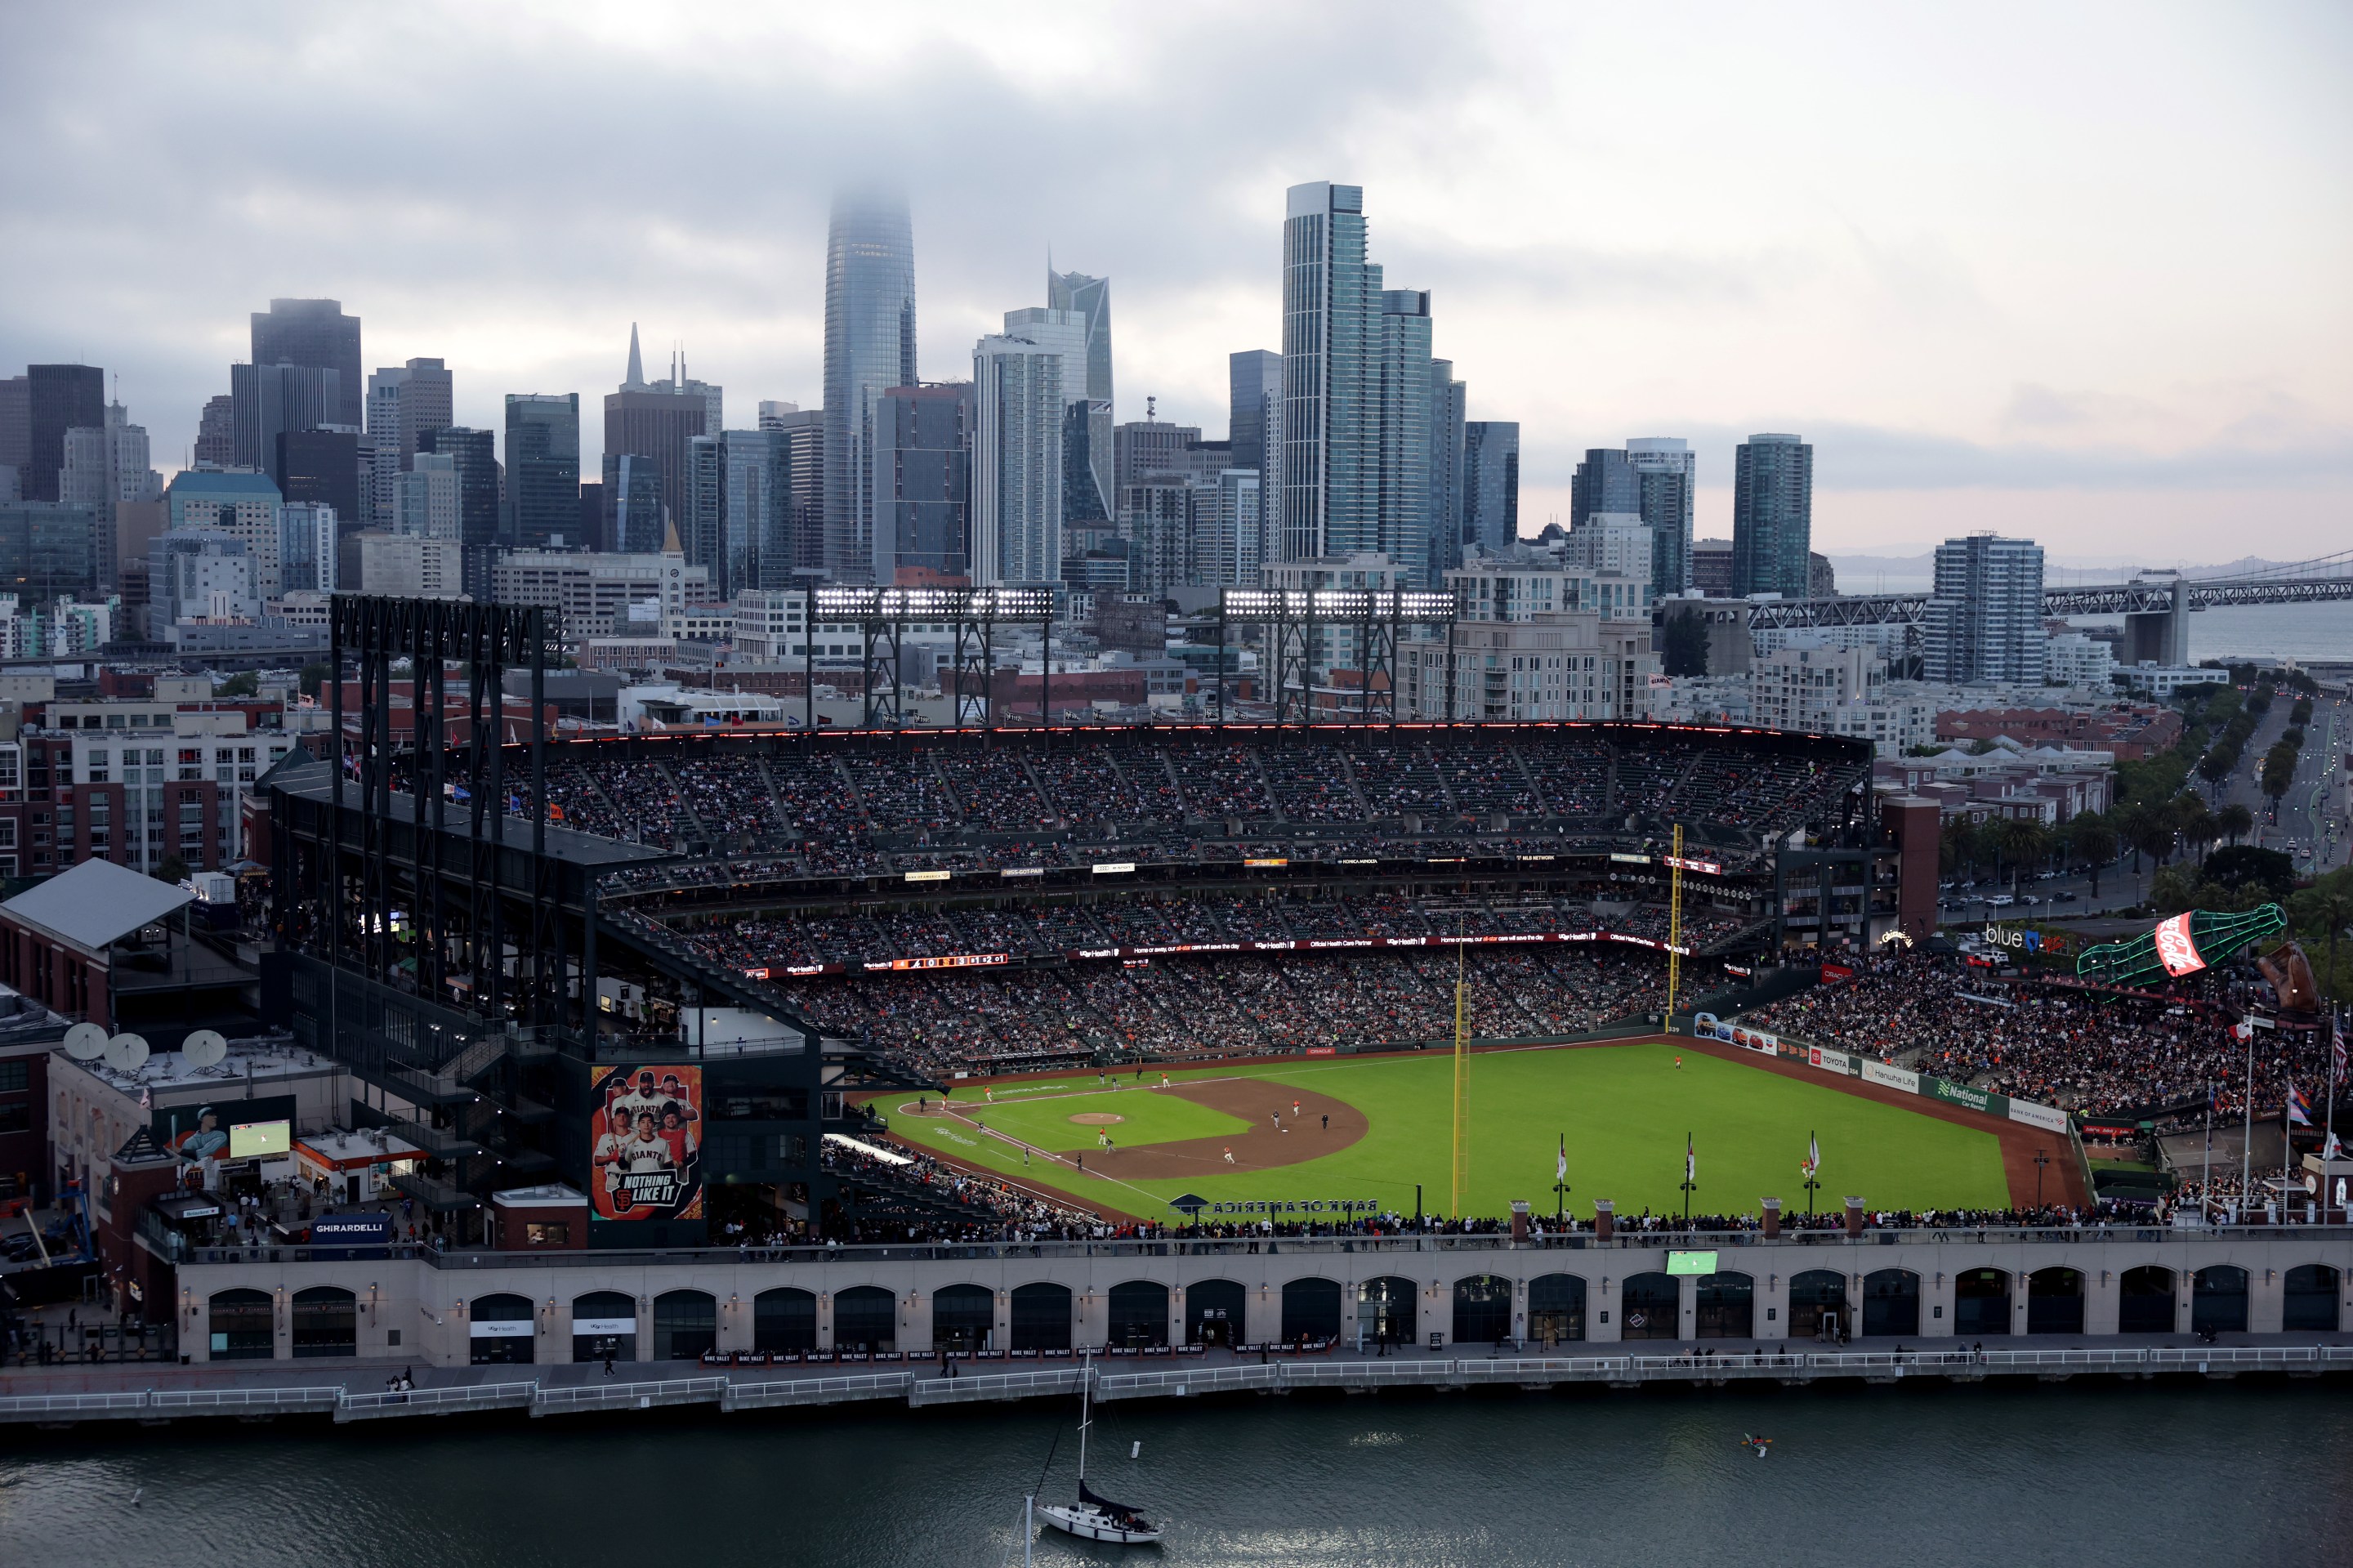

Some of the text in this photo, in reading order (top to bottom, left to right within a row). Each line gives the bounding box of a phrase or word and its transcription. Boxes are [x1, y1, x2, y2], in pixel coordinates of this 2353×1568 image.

[1986, 922, 2022, 948] blue
[1267, 941, 1287, 949] Health
[1732, 964, 1745, 974] Health
[1823, 1056, 1847, 1069] TOYOTA
[1850, 1067, 1859, 1075] 354
[1875, 1069, 1917, 1088] Hanwha Life
[1949, 1085, 1988, 1106] National
[1962, 1100, 1986, 1112] Car Rental
[2031, 1112, 2055, 1124] AMERICA
[631, 1150, 663, 1161] GIANTS
[623, 1175, 672, 1190] NOTHING
[632, 1185, 676, 1202] LIKE IT
[316, 1224, 382, 1232] GHIRARDELLI
